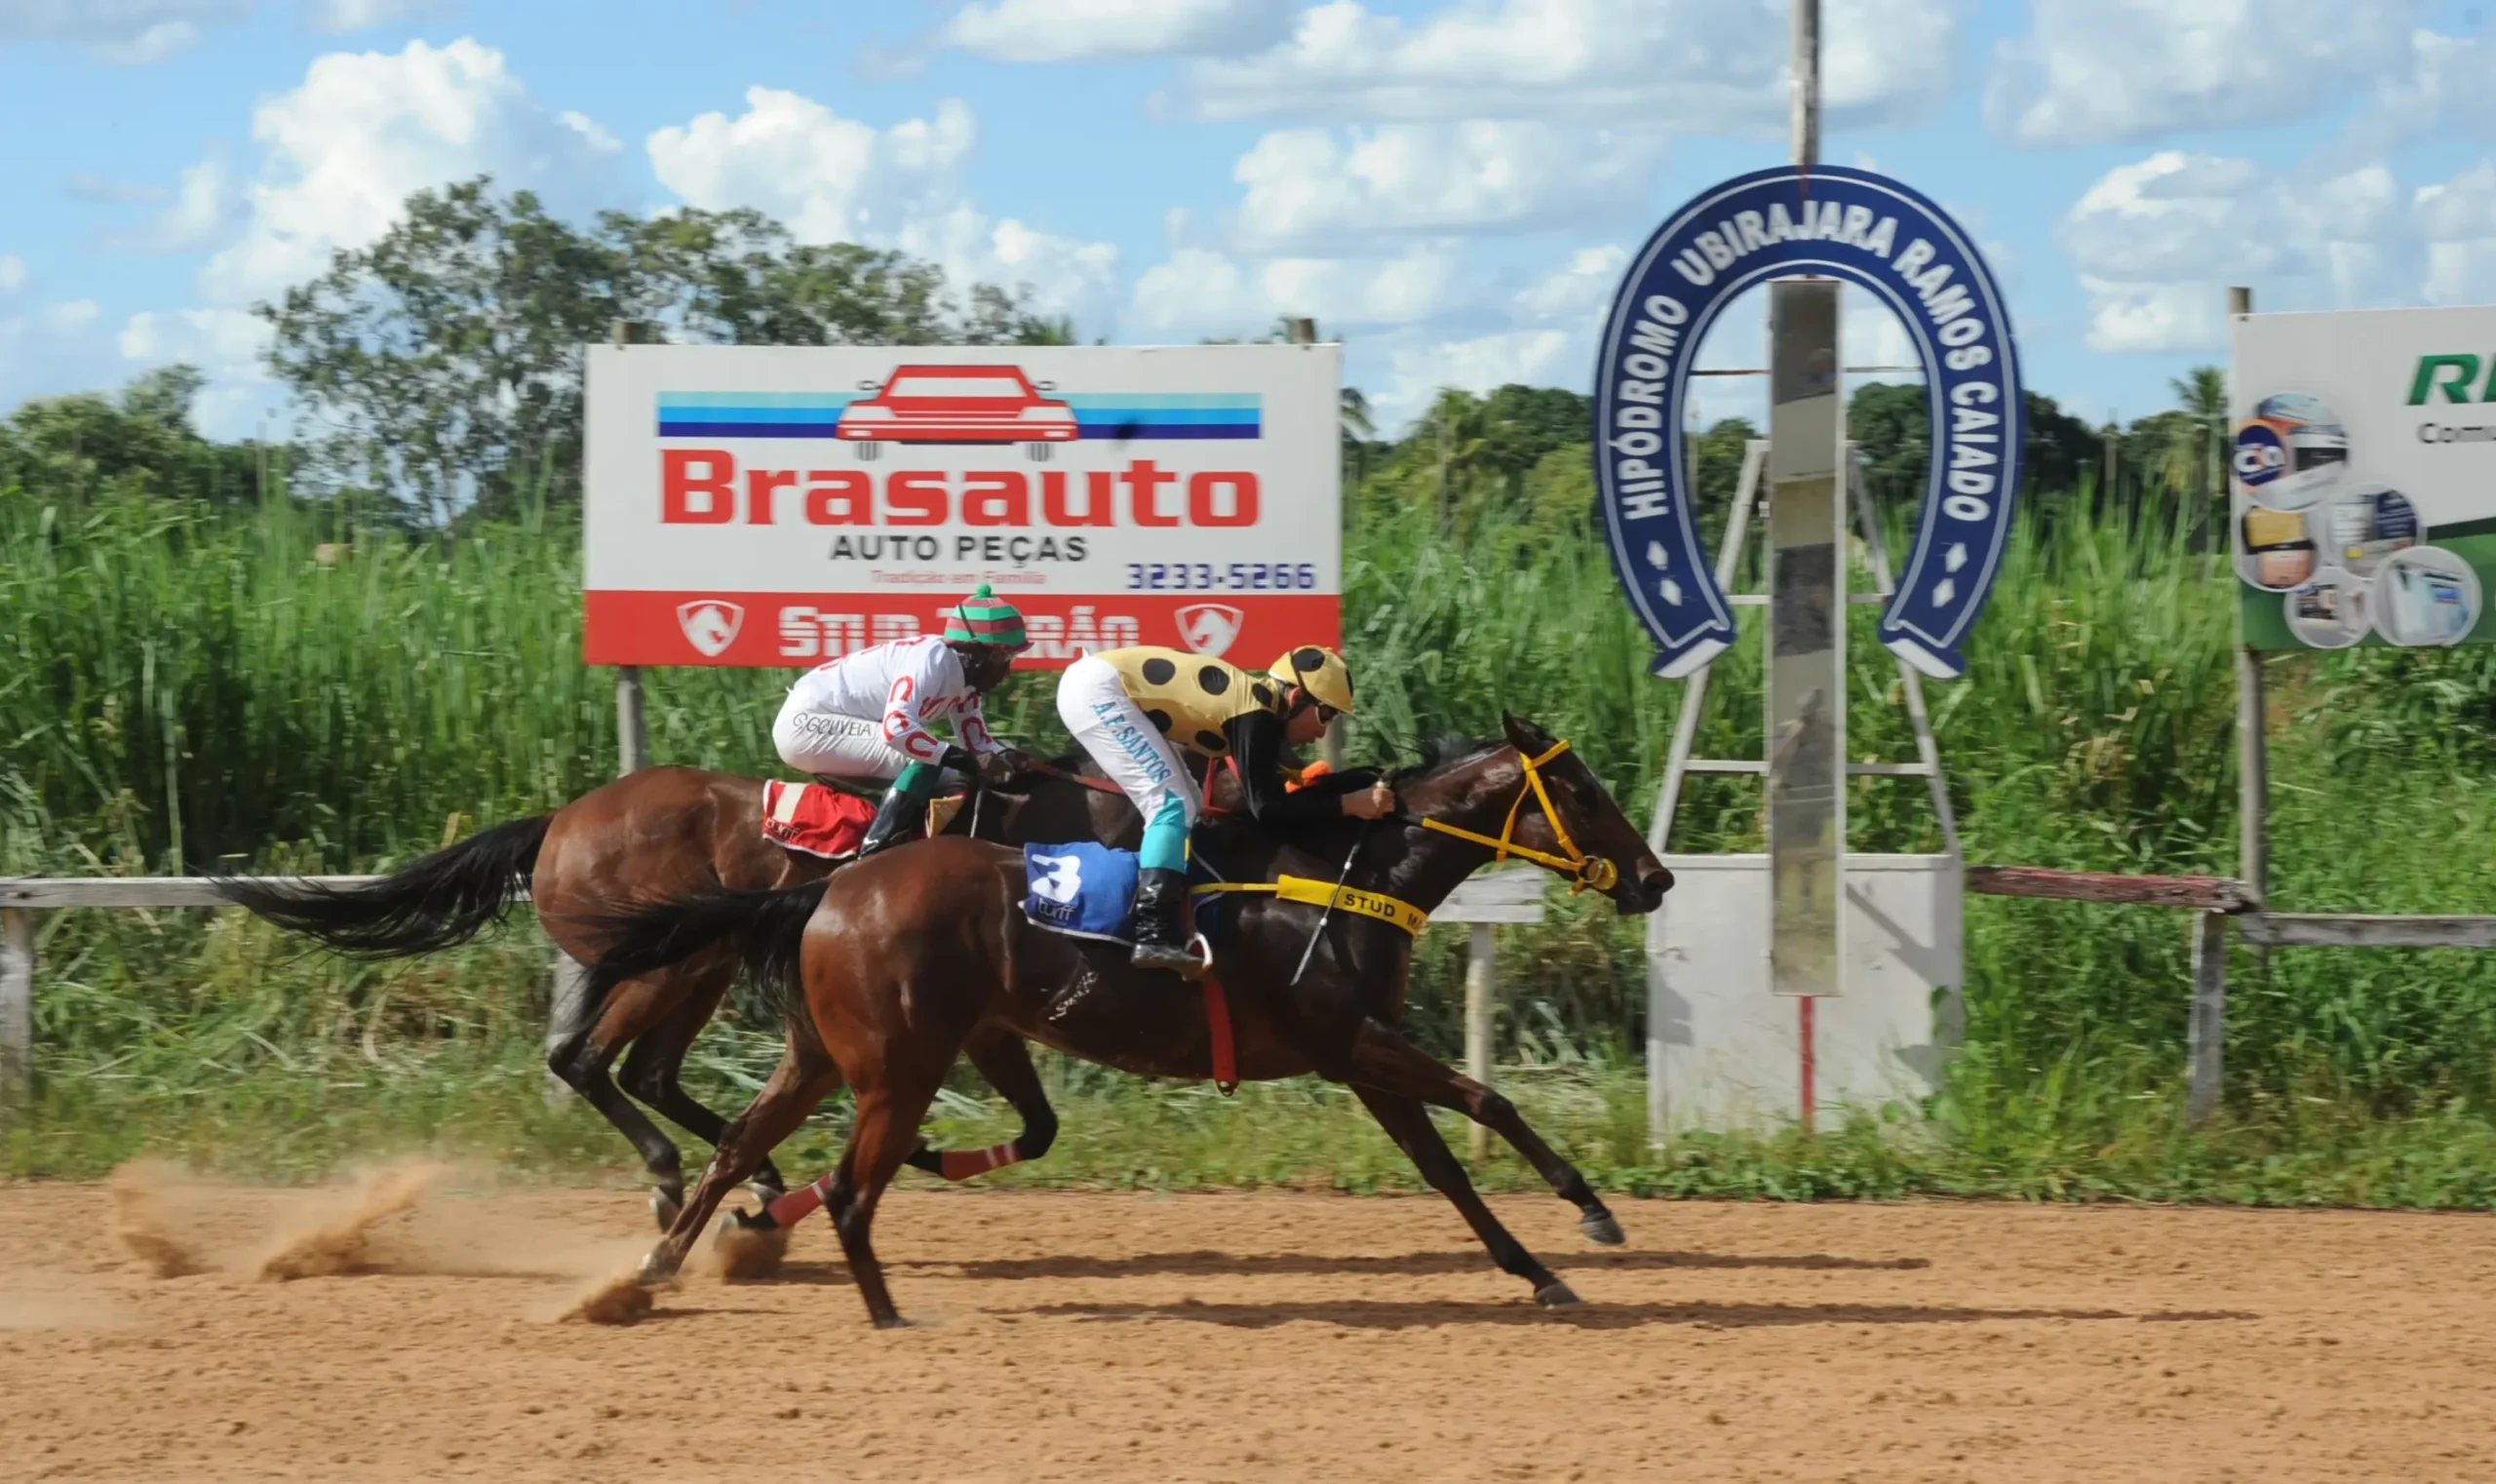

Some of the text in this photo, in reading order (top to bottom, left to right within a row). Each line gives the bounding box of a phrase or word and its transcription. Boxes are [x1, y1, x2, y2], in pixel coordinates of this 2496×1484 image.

[1607, 200, 2000, 523] HIPÓDROMO UBIRAJARA RAMOS CAIADO
[659, 449, 1261, 527] Brasauto
[829, 535, 1088, 568] AUTO PEÇAS
[1344, 893, 1396, 918] STUD
